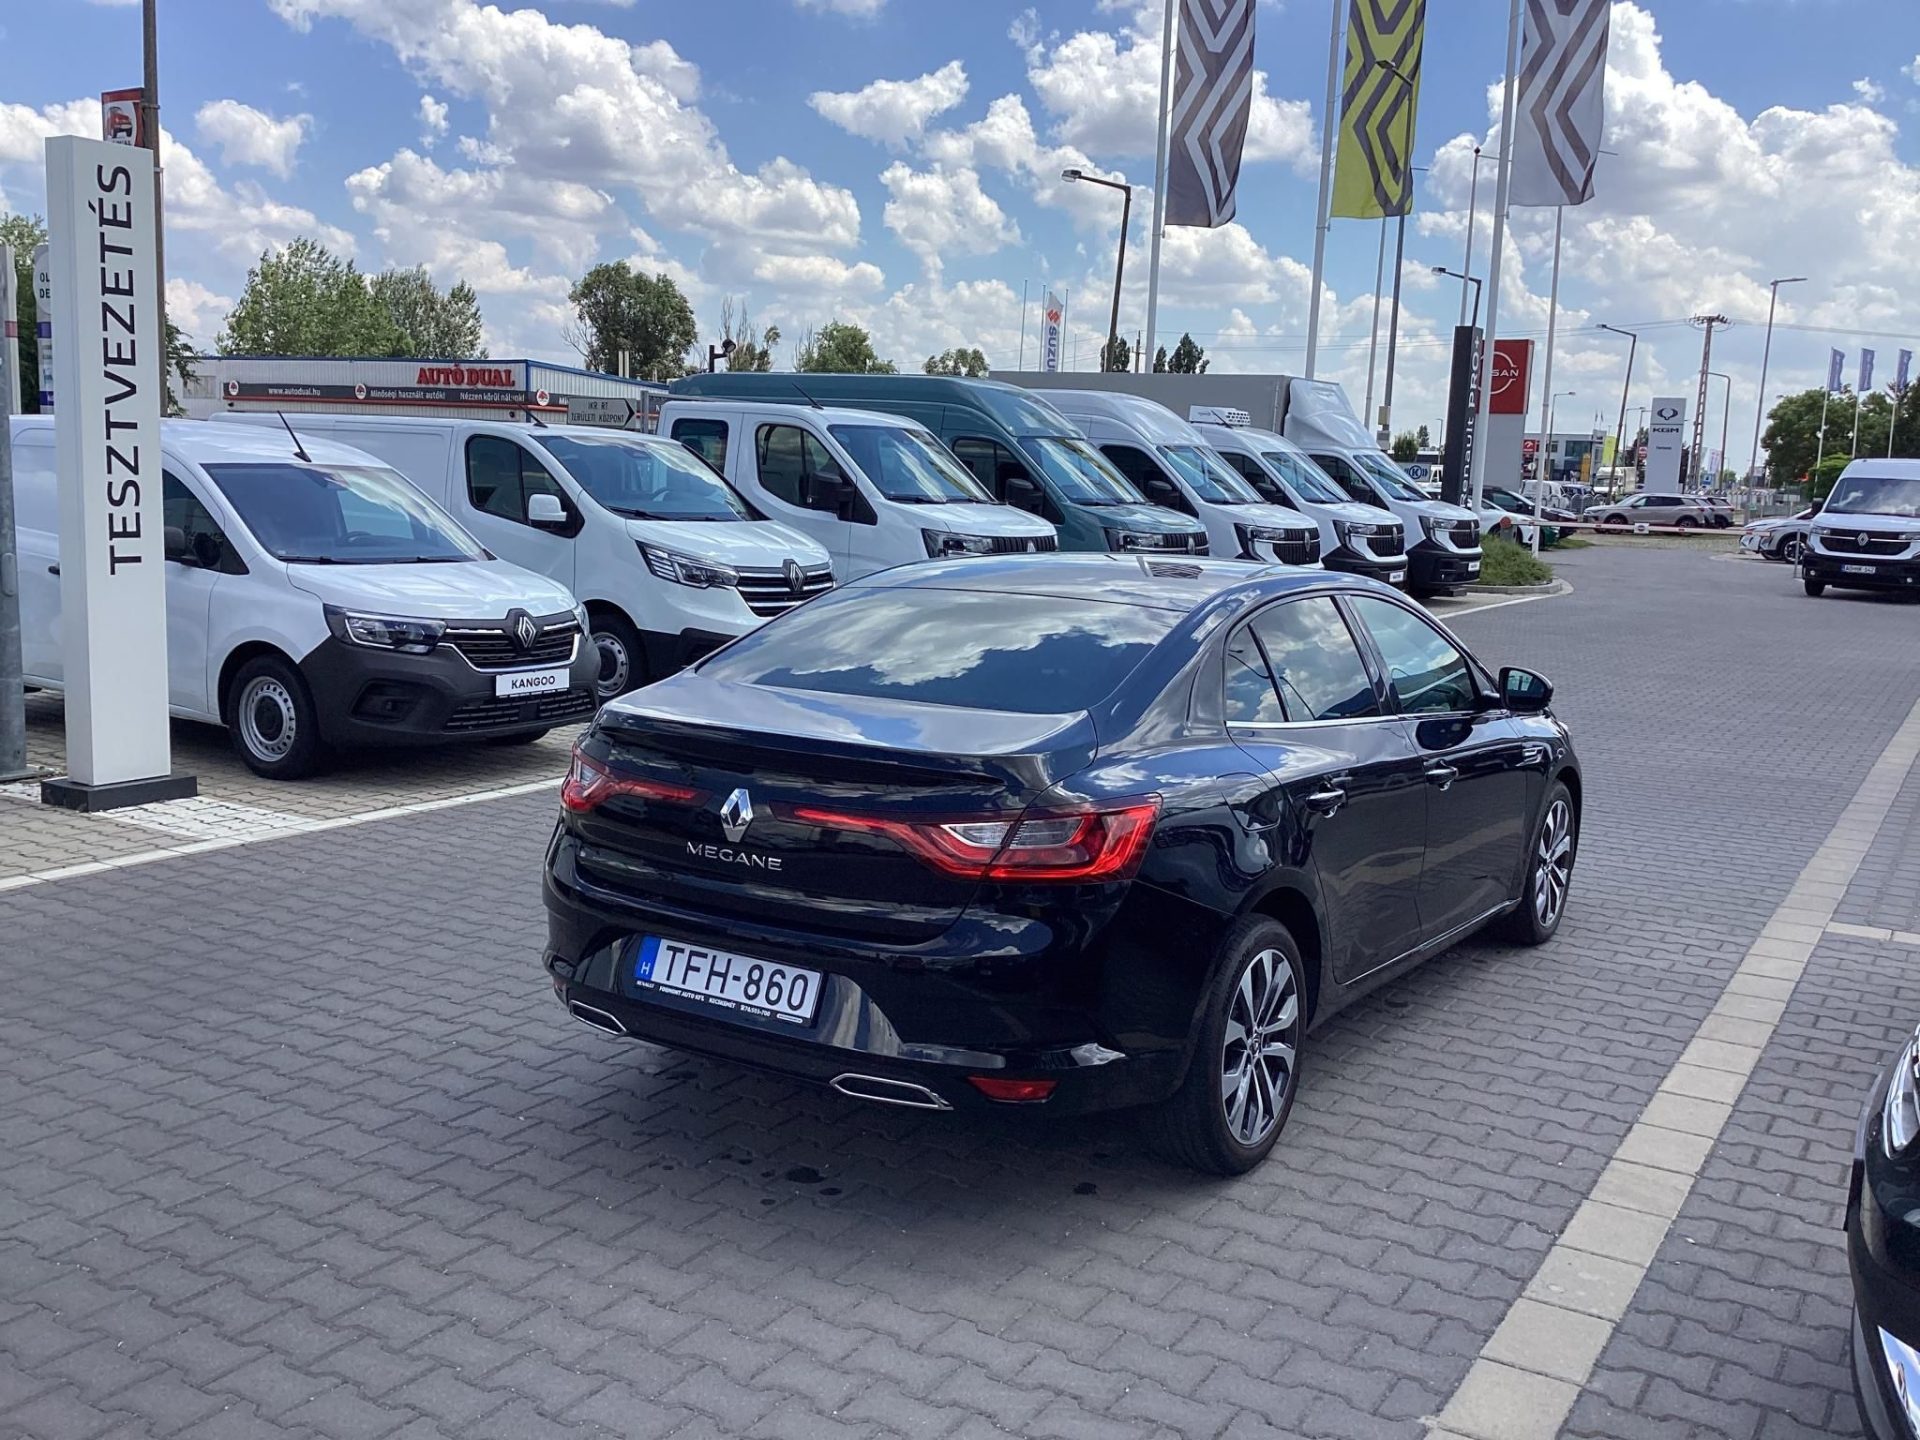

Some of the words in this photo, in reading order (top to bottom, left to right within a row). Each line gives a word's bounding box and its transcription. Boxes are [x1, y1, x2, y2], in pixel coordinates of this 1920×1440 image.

[88, 163, 143, 576] TESZTVEZETÉS
[466, 368, 516, 387] DUAL
[1491, 369, 1520, 377] SAN
[268, 388, 321, 396] www.autodual.hu
[511, 675, 556, 690] KANGOO
[686, 841, 783, 871] MEGANE
[640, 961, 651, 976] H
[665, 945, 809, 1011] TFH-860
